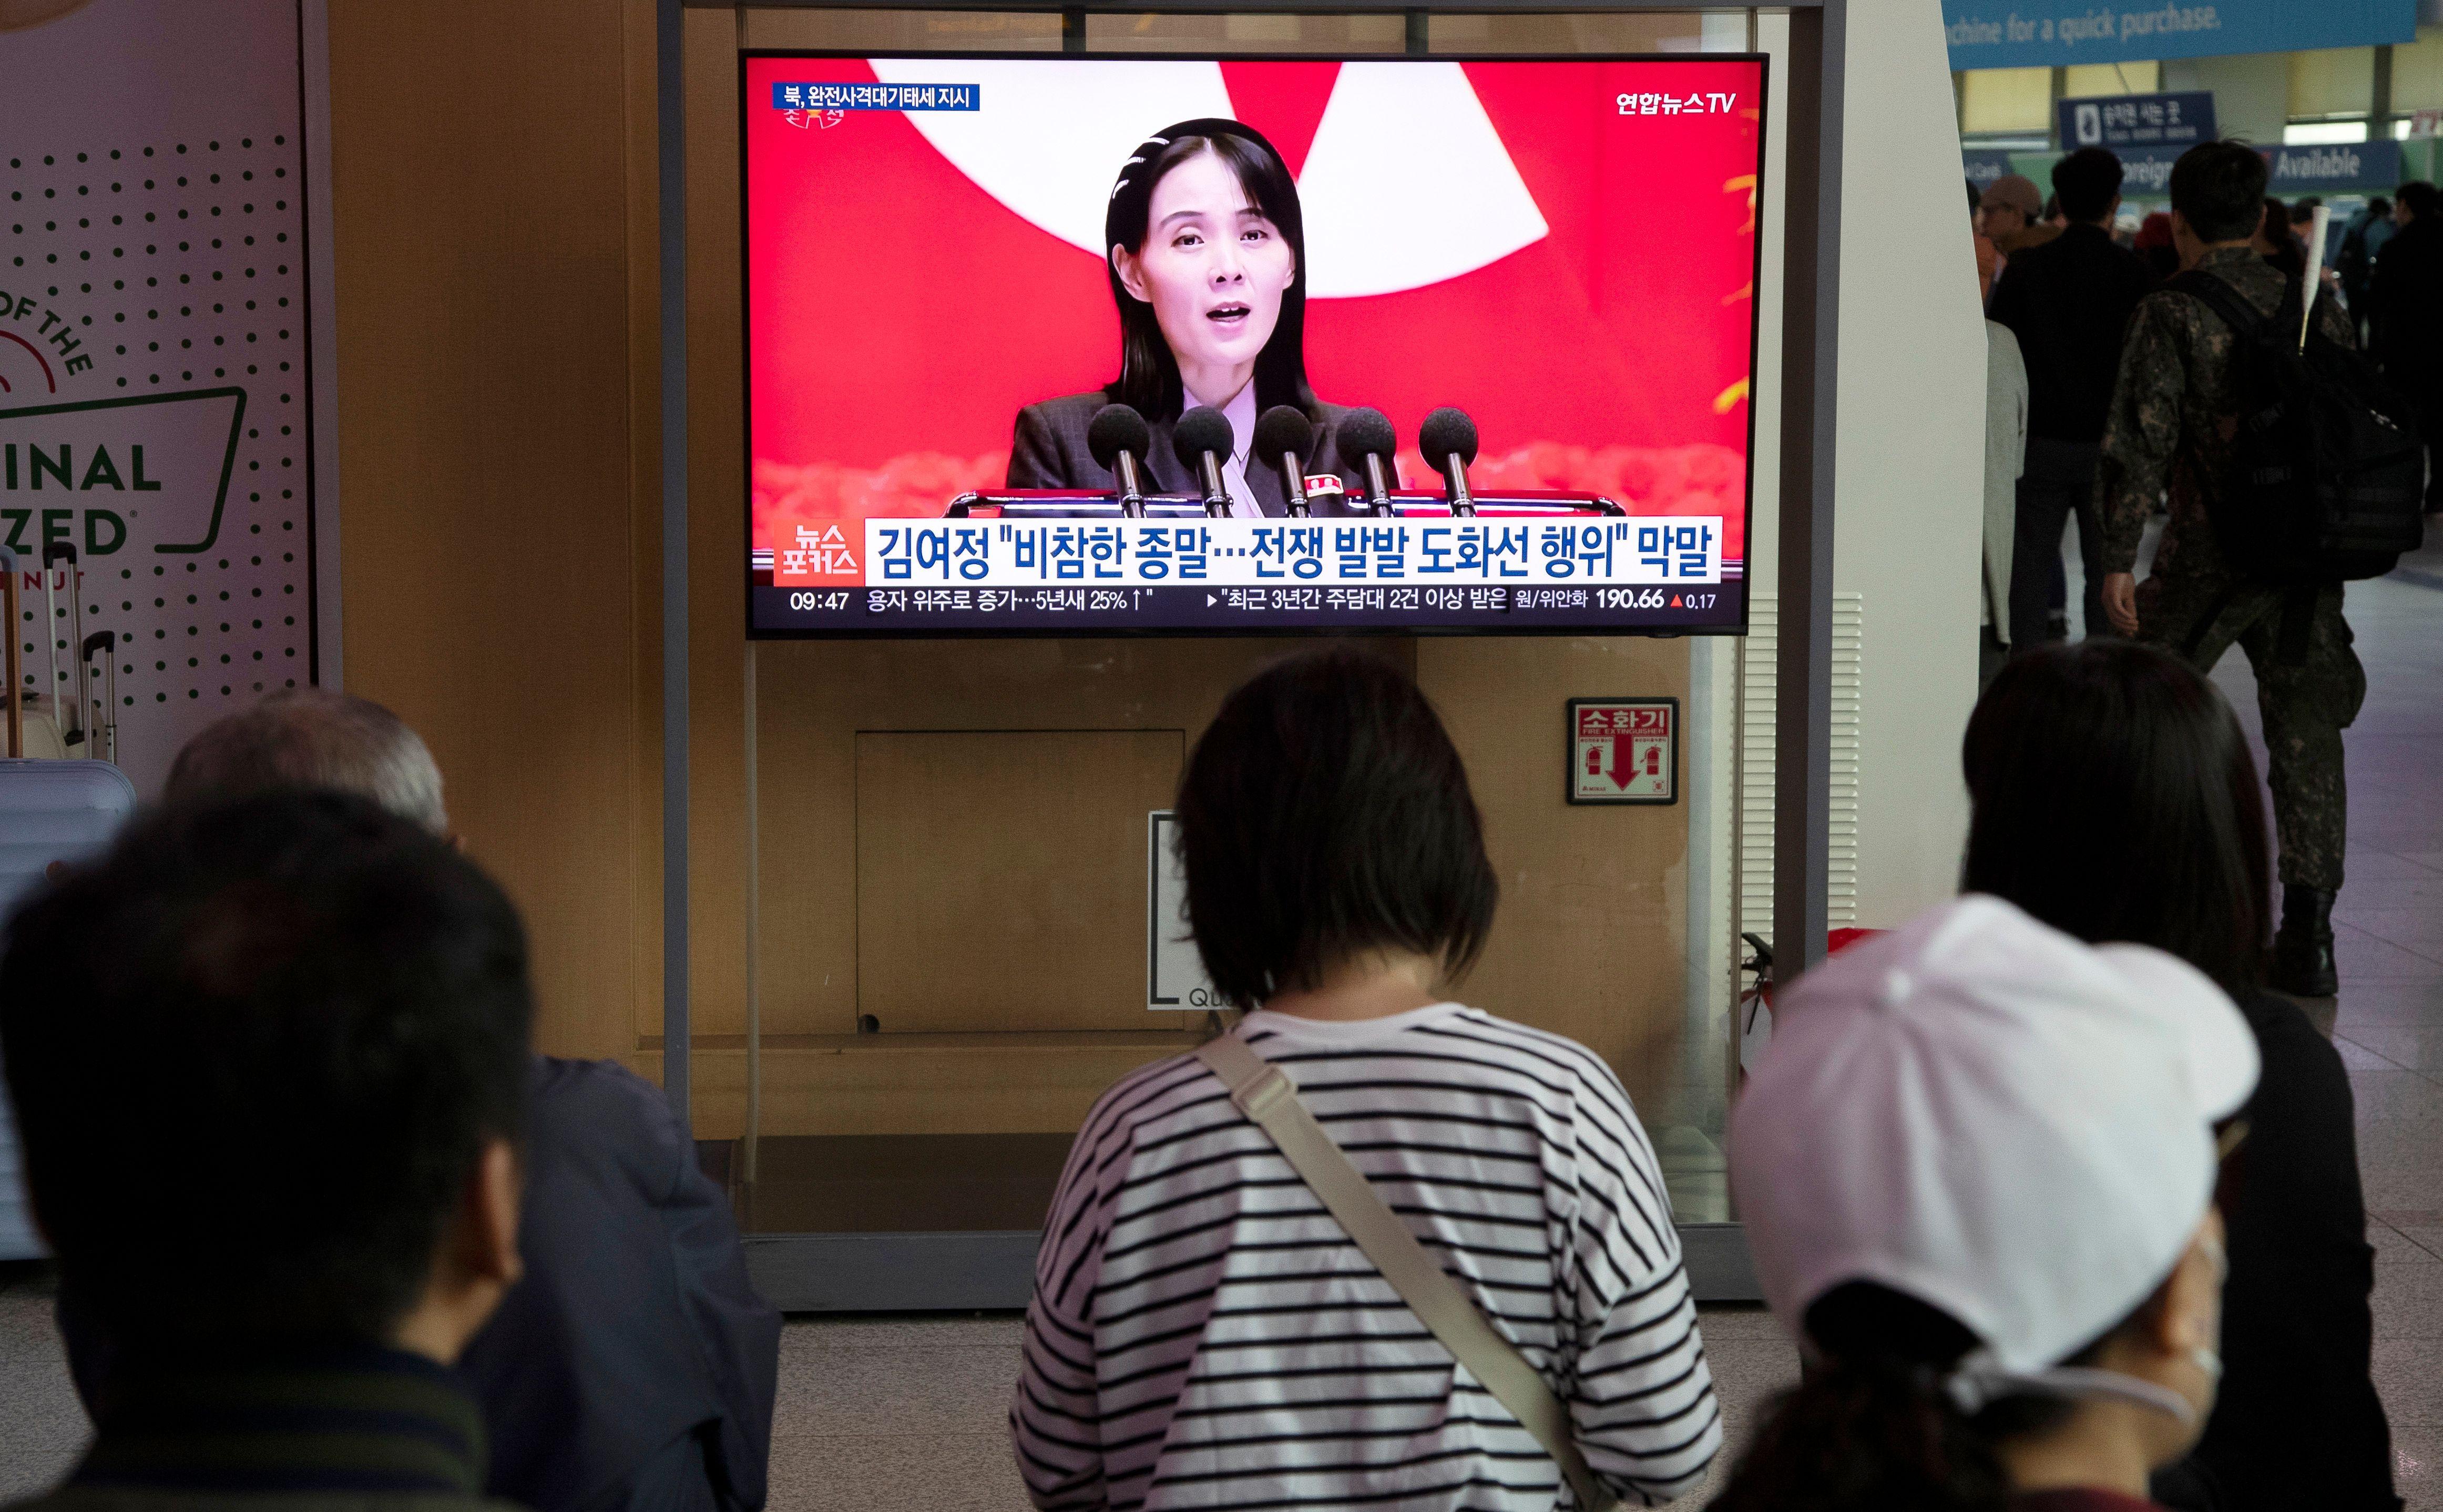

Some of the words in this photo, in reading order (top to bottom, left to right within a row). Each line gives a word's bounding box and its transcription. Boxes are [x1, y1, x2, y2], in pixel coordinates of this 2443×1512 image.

[1945, 15, 2001, 46] achine
[2007, 13, 2036, 42] for
[2040, 19, 2054, 42] a
[2058, 7, 2115, 48] quick
[784, 86, 805, 109] 북,
[809, 86, 935, 108] 완전사격대기태세
[938, 88, 969, 108] 지시
[1617, 93, 1737, 115] 연합뉴스TV
[2121, 156, 2174, 190] oreign
[2274, 145, 2362, 179] Available
[0, 290, 37, 321] OF
[37, 309, 94, 377] THE
[5, 443, 162, 491] INAL
[795, 525, 847, 549] 뉴스
[783, 550, 859, 575] 포커스
[879, 528, 989, 580] 김여정
[1000, 525, 1128, 580] "비참한
[1336, 527, 1410, 578] 발발
[1418, 526, 1529, 578] 도화선
[1541, 524, 1628, 579] 행위"
[1639, 526, 1713, 578] 막말
[791, 592, 850, 611] 09:47
[867, 590, 908, 612] 용자
[913, 590, 973, 612] 위주로
[1222, 589, 1268, 610] "최근
[1272, 589, 1322, 610] 3년간
[1326, 588, 1385, 610] 주담대
[1390, 588, 1419, 610] 2건
[1426, 588, 1465, 610] 이상
[1471, 588, 1507, 609] 받은
[1516, 590, 1589, 609] 원/위안화
[1597, 589, 1665, 609] 190.66
[1686, 595, 1716, 610] 0.17
[1583, 710, 1664, 729] 소화기
